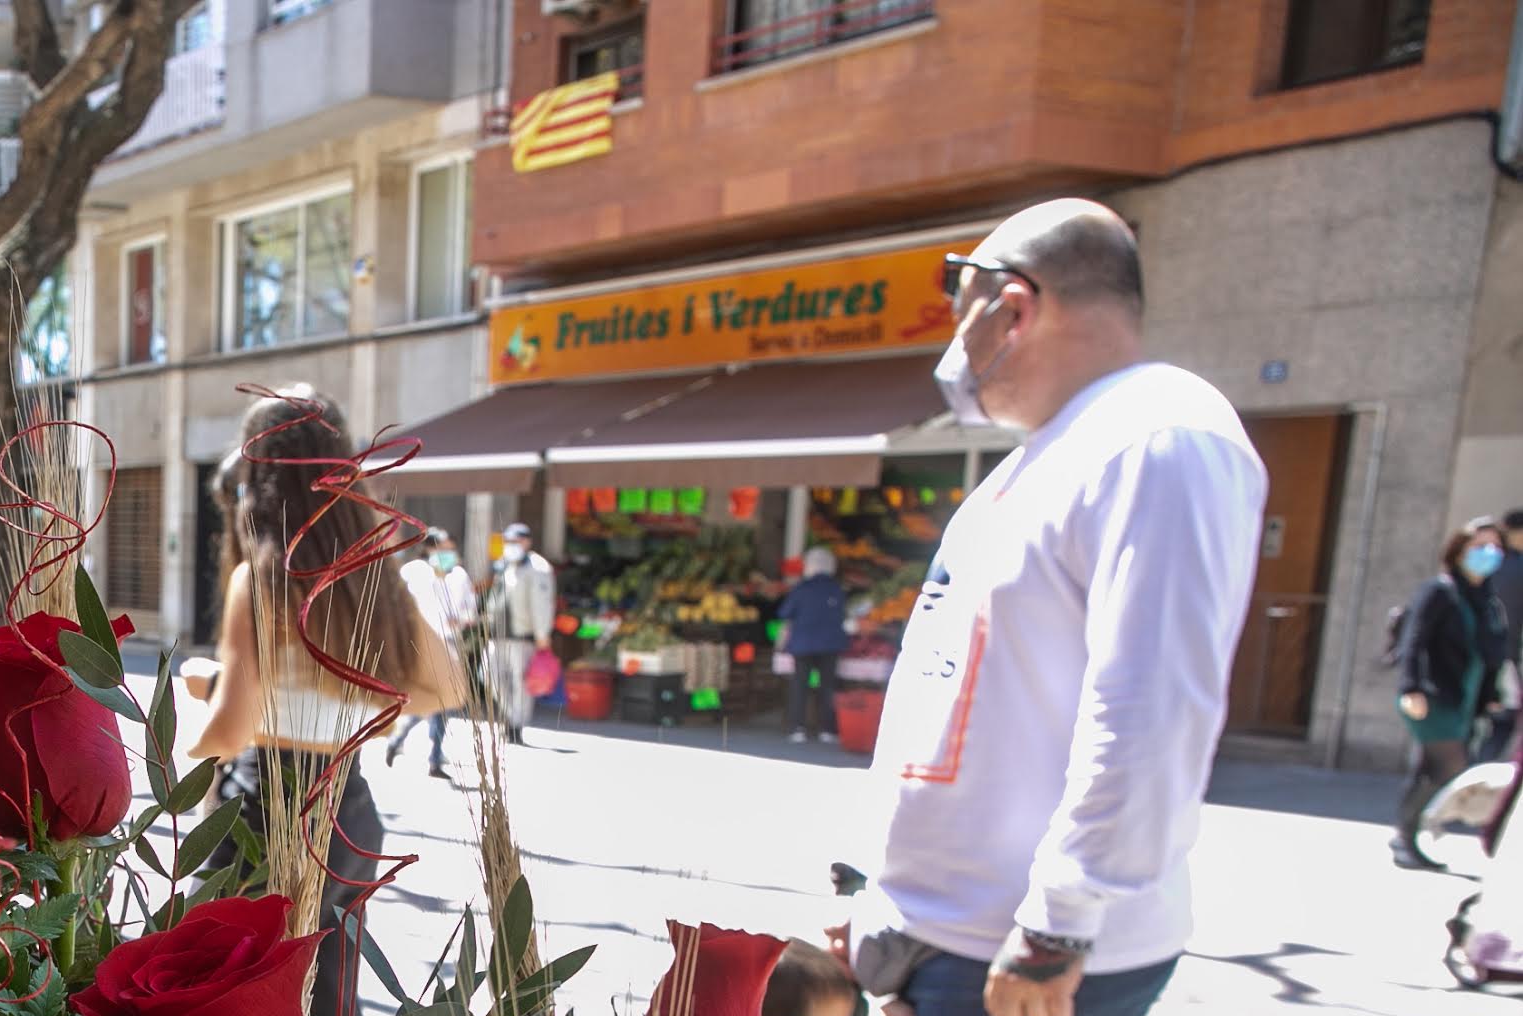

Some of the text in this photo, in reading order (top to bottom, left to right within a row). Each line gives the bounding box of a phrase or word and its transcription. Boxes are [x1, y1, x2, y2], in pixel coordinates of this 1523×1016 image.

[556, 281, 888, 348] Fruites i Verdures
